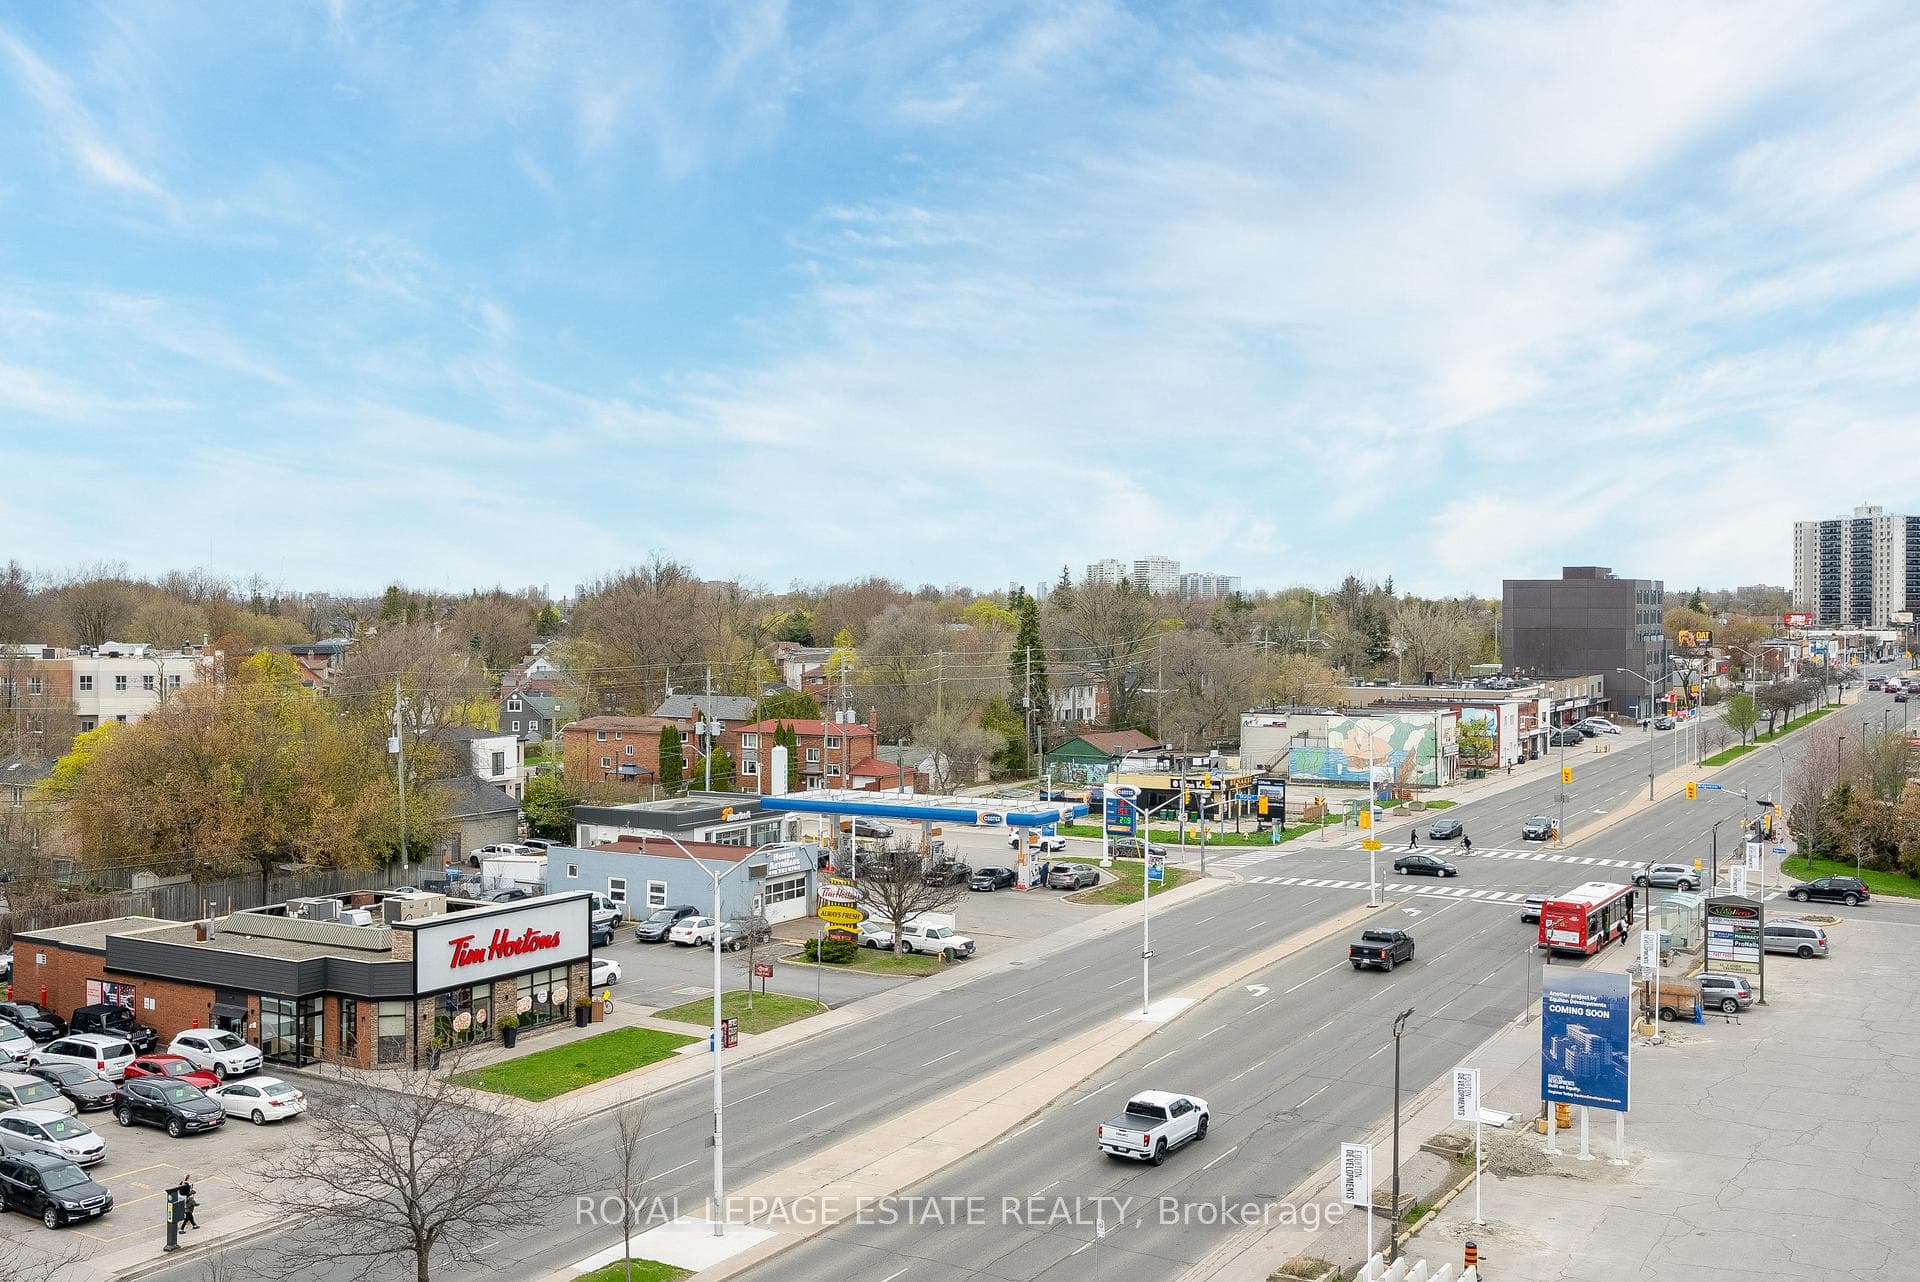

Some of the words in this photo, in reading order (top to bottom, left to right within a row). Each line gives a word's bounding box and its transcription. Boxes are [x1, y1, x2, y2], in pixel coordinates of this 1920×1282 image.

[842, 912, 860, 920] FRESH
[448, 935, 486, 968] Tim
[488, 928, 560, 960] Hortons
[1549, 1004, 1584, 1016] COMING
[1585, 1008, 1610, 1019] SOON
[1346, 1149, 1355, 1200] DEVELOPMENTS
